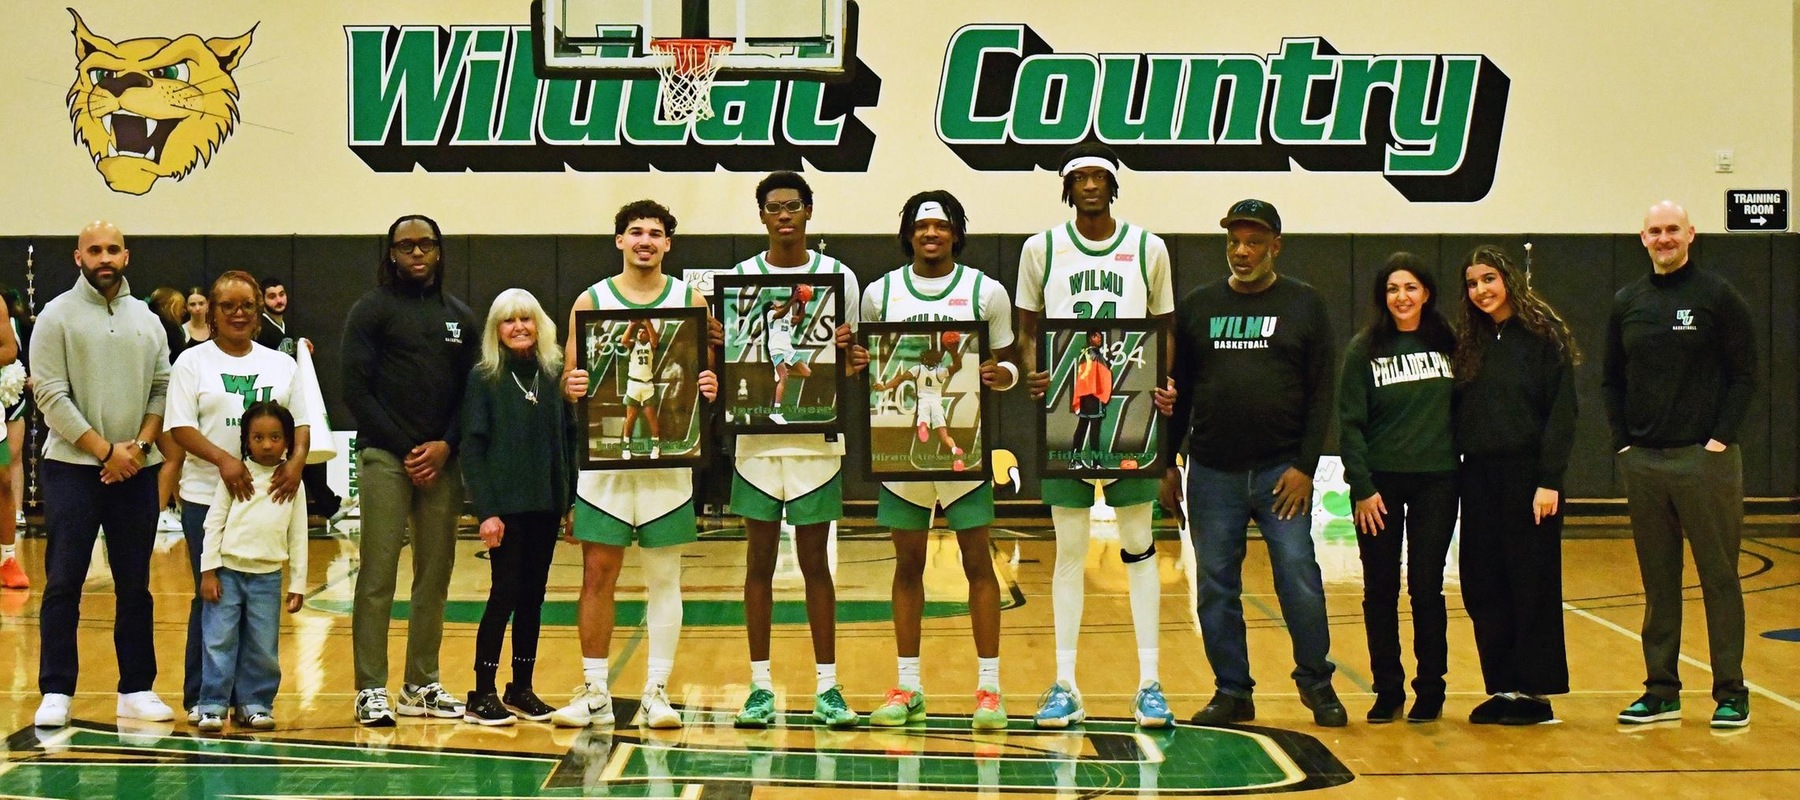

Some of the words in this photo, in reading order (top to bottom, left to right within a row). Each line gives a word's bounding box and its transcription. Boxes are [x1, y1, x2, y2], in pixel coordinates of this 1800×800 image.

[343, 23, 850, 148] Wildcat
[935, 22, 1488, 177] Country
[1733, 193, 1781, 204] TRAINING
[1743, 204, 1774, 215] ROOM
[1069, 269, 1123, 297] WILMU
[1210, 315, 1277, 338] WILMU
[1213, 340, 1269, 349] BASKETBALL
